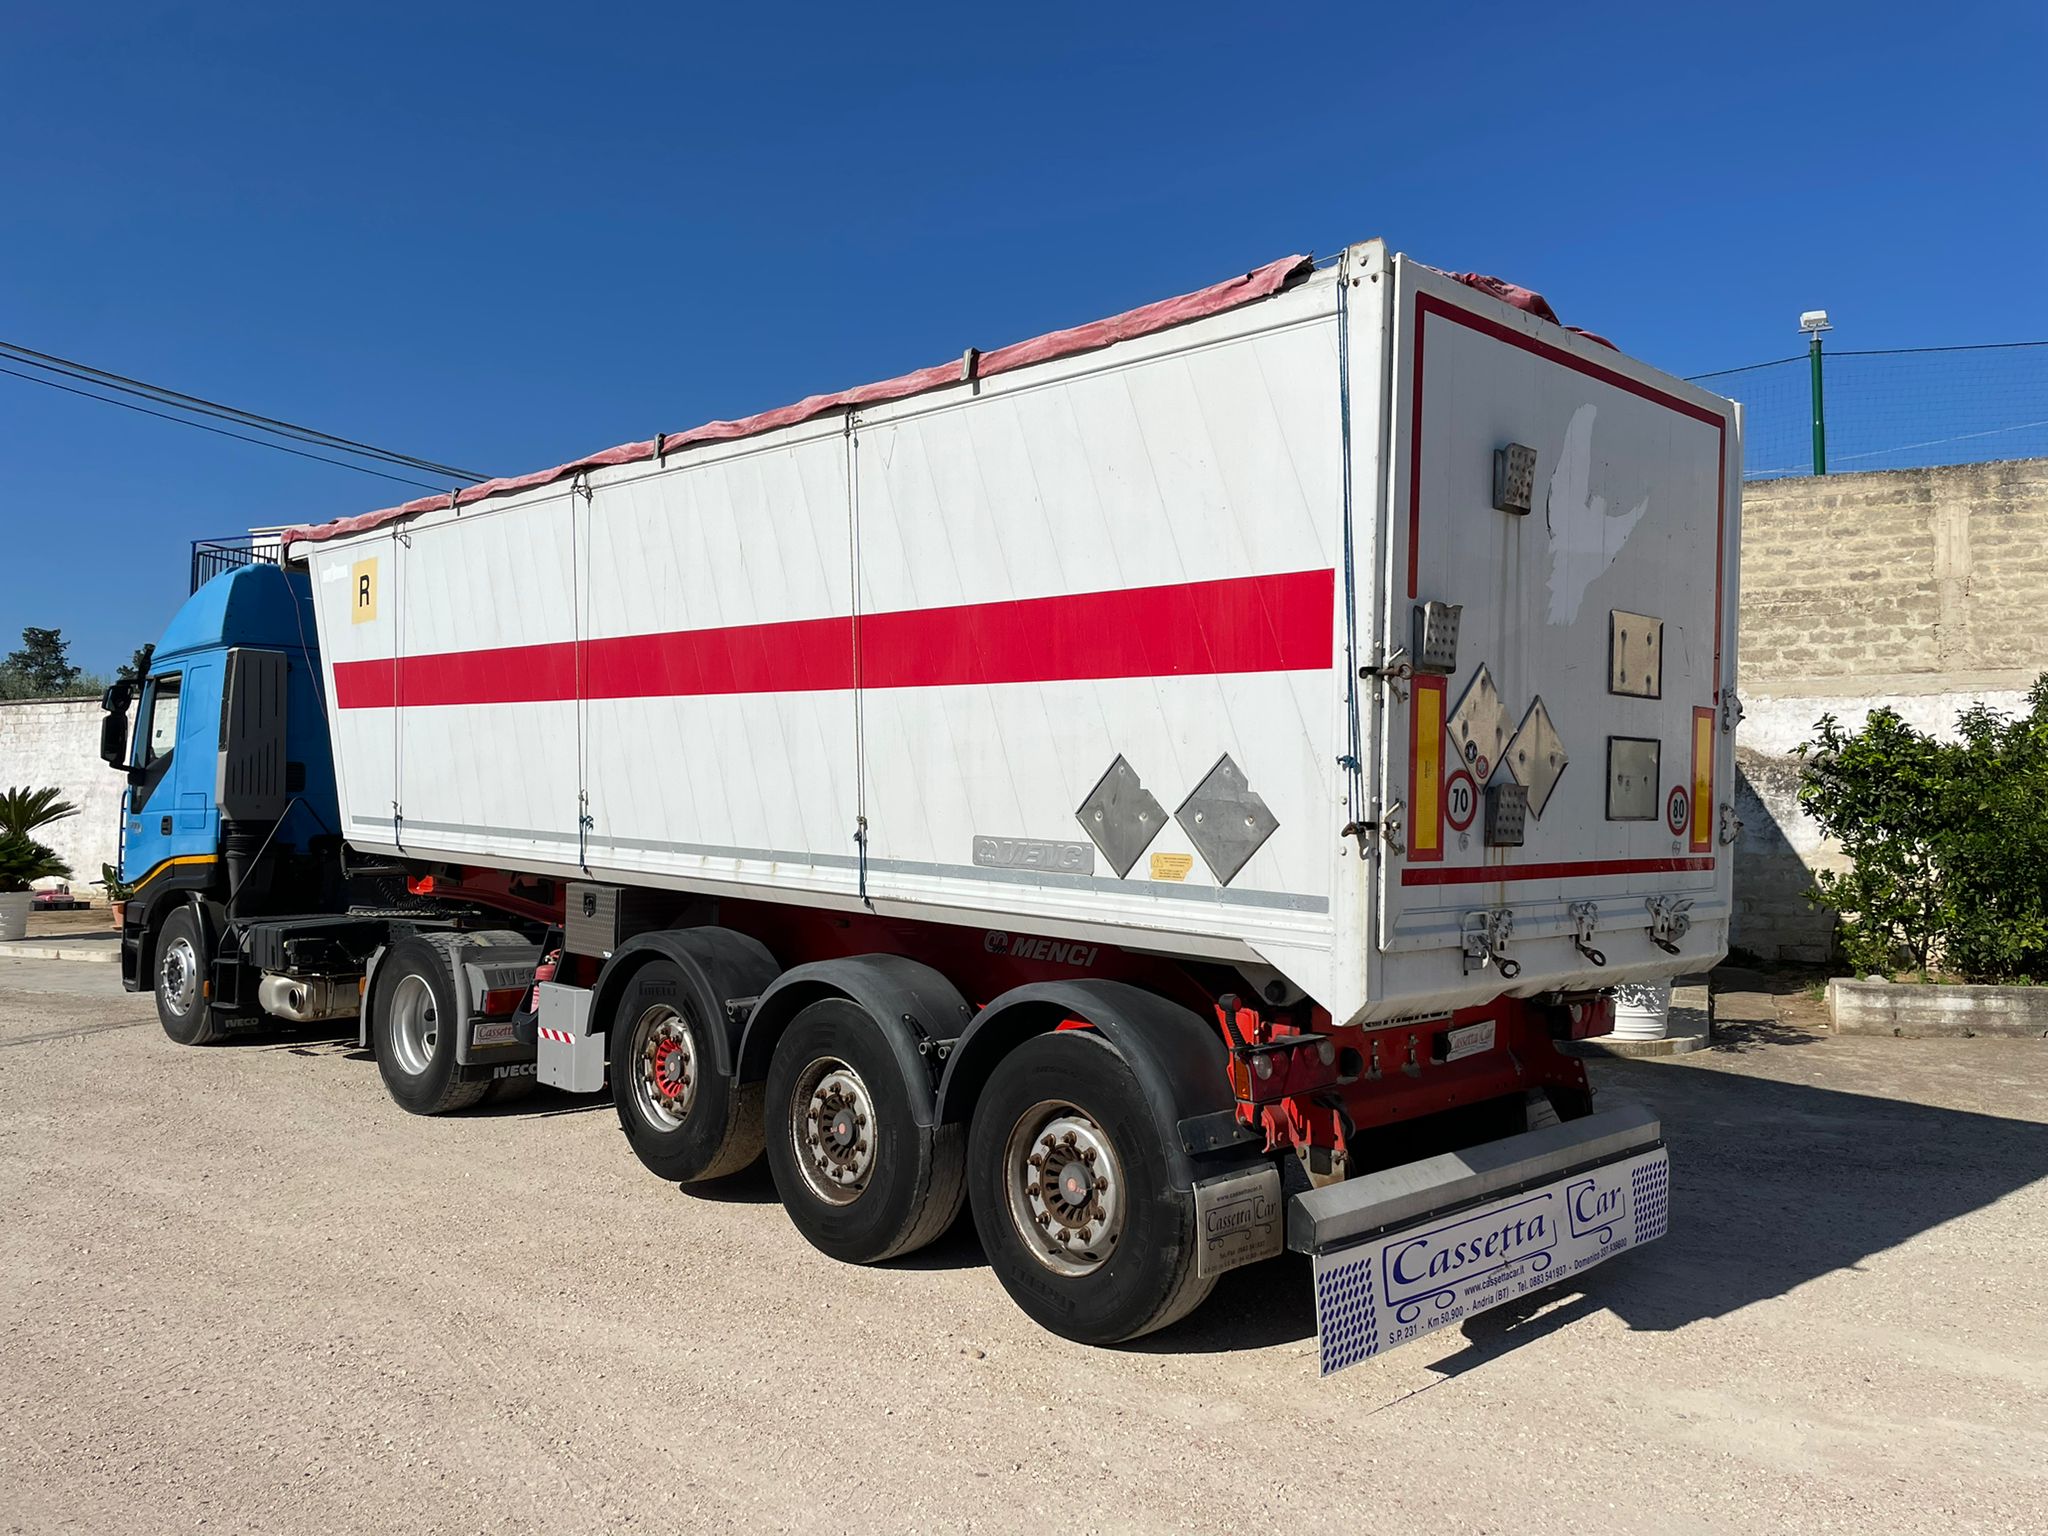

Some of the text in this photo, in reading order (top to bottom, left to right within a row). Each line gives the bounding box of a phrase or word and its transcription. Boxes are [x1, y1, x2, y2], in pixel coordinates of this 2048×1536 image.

[358, 574, 370, 608] R
[1452, 787, 1469, 813] 70
[1672, 798, 1685, 819] 80
[1010, 937, 1099, 967] MENCI
[496, 969, 533, 986] IVEC
[224, 1017, 259, 1028] IVECO
[480, 1024, 513, 1039] Cassett
[1207, 1199, 1277, 1232] Cassetta Car
[1392, 1185, 1622, 1285] Cassetta Car
[1463, 1266, 1525, 1297] www.cassettacar.it
[1404, 1324, 1418, 1340] 231
[1427, 1317, 1440, 1329] Km
[1472, 1296, 1494, 1312] Andria
[1495, 1287, 1510, 1303] (BT)
[1517, 1281, 1529, 1293] Tel.
[1529, 1273, 1545, 1289] 0883
[1544, 1264, 1567, 1283] 541937
